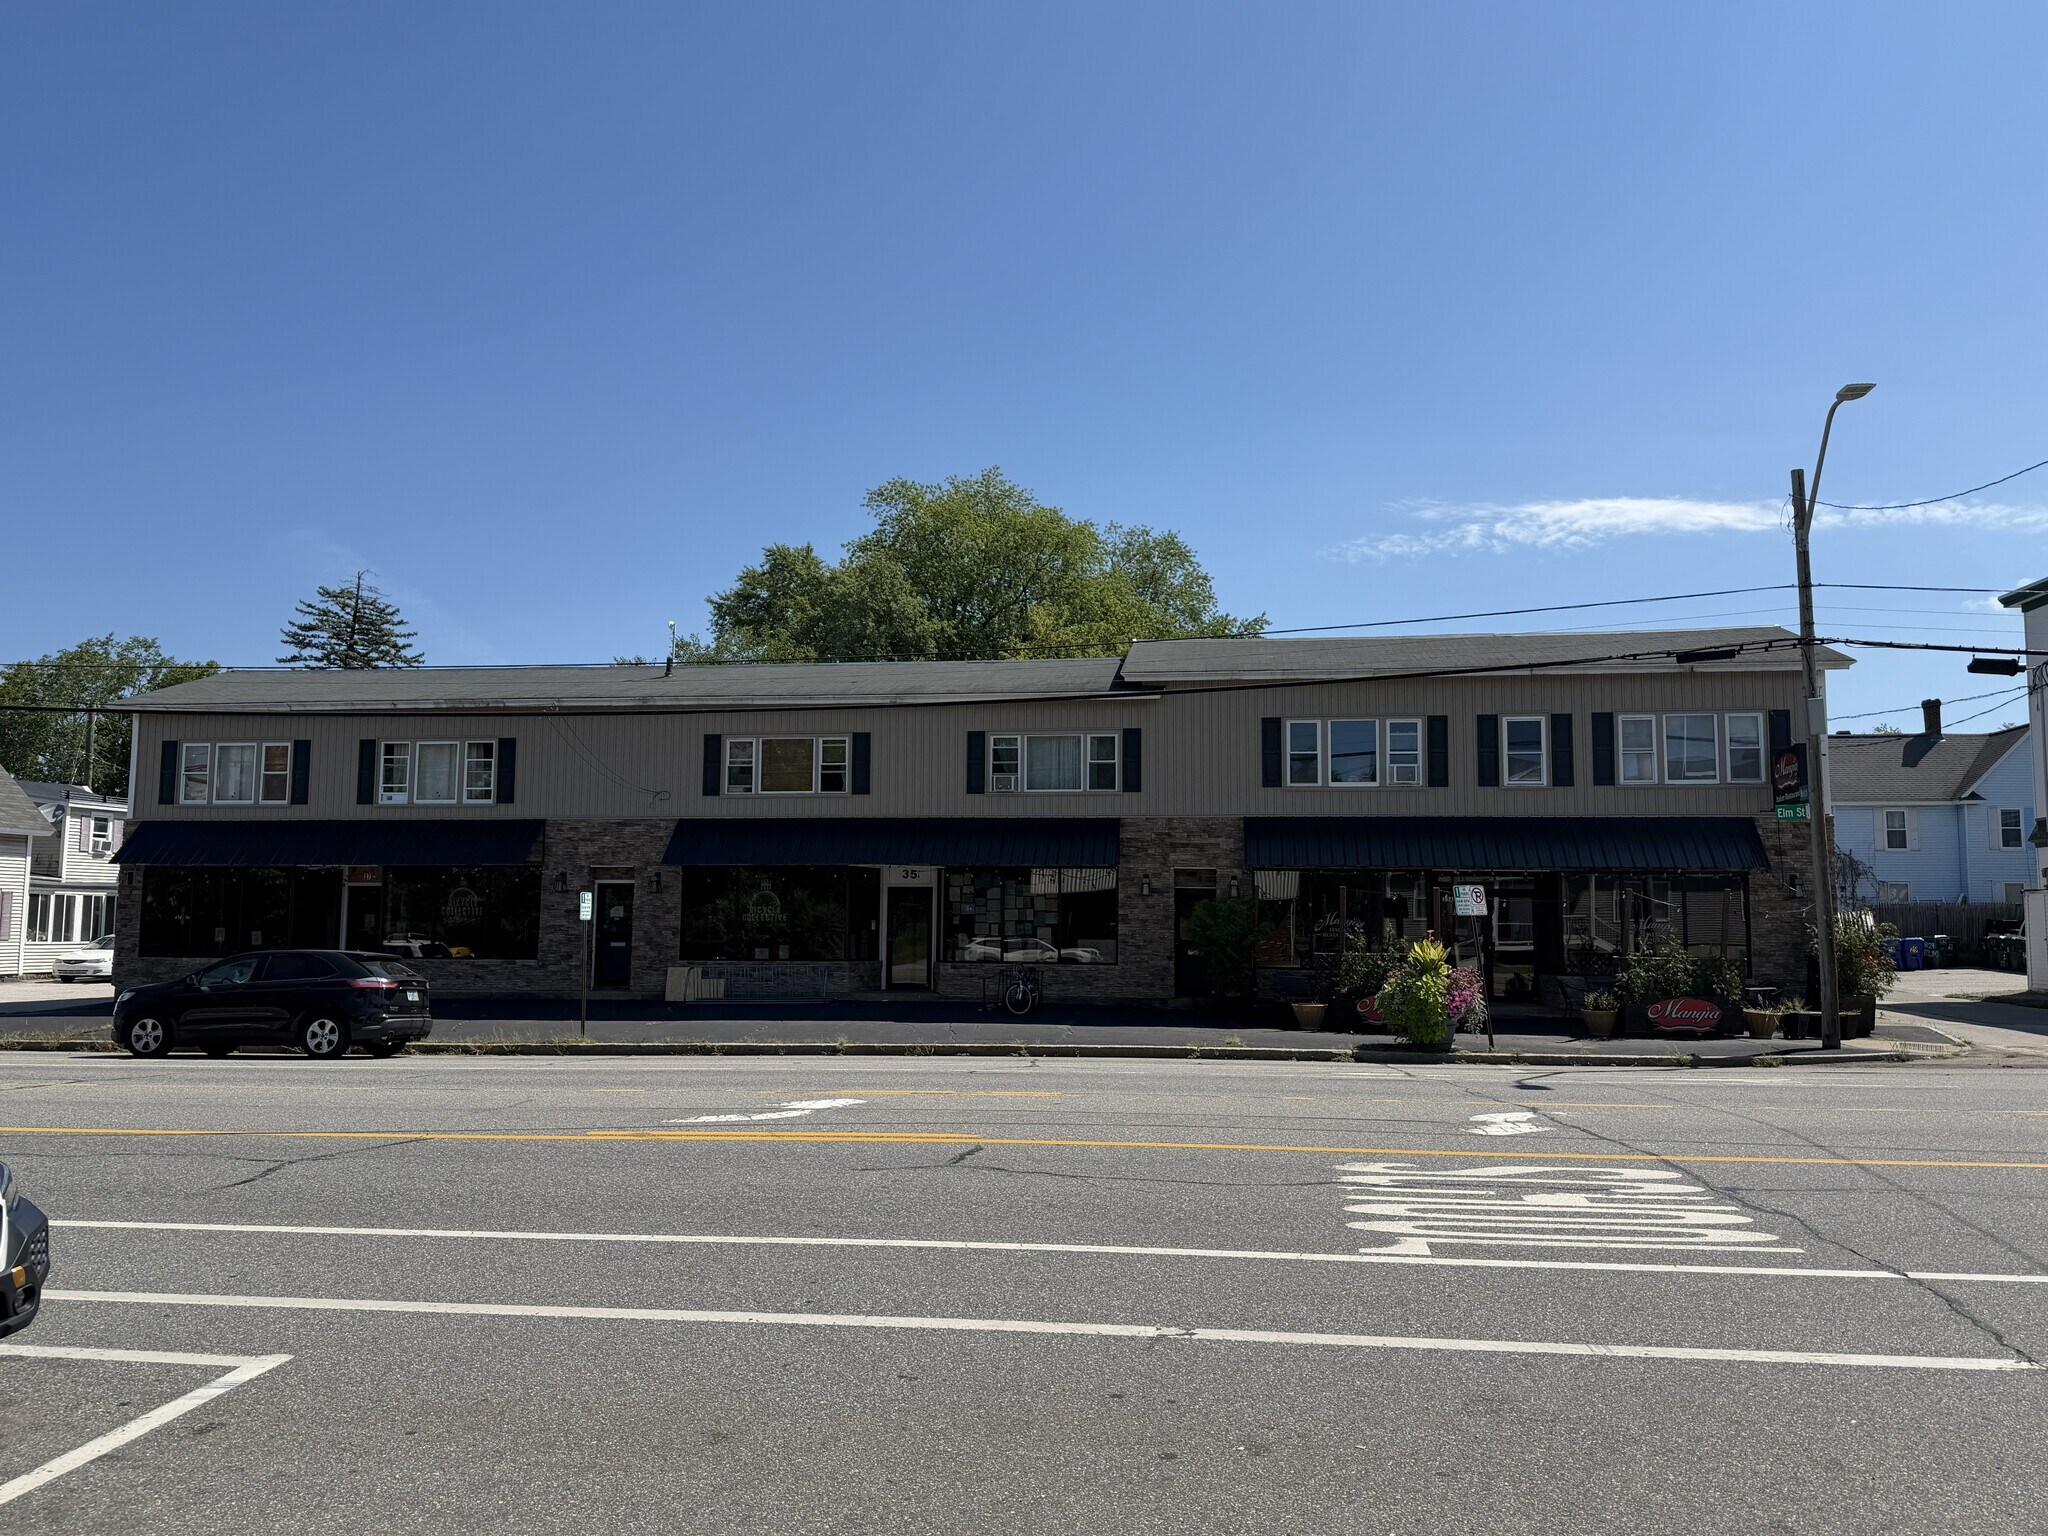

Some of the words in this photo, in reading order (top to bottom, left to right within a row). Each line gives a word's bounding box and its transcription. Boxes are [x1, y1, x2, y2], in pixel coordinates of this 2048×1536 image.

[1775, 756, 1798, 779] Mangia
[1777, 808, 1793, 818] Elm
[1796, 807, 1805, 817] St
[902, 869, 917, 879] 35
[448, 897, 478, 906] BICYCLE
[440, 906, 483, 915] COLLECTIVE
[749, 905, 781, 913] BICYCLE
[742, 913, 788, 921] COLLECTIVE
[1648, 999, 1720, 1023] Mangia
[1335, 1162, 1805, 1256] SCHOOL
